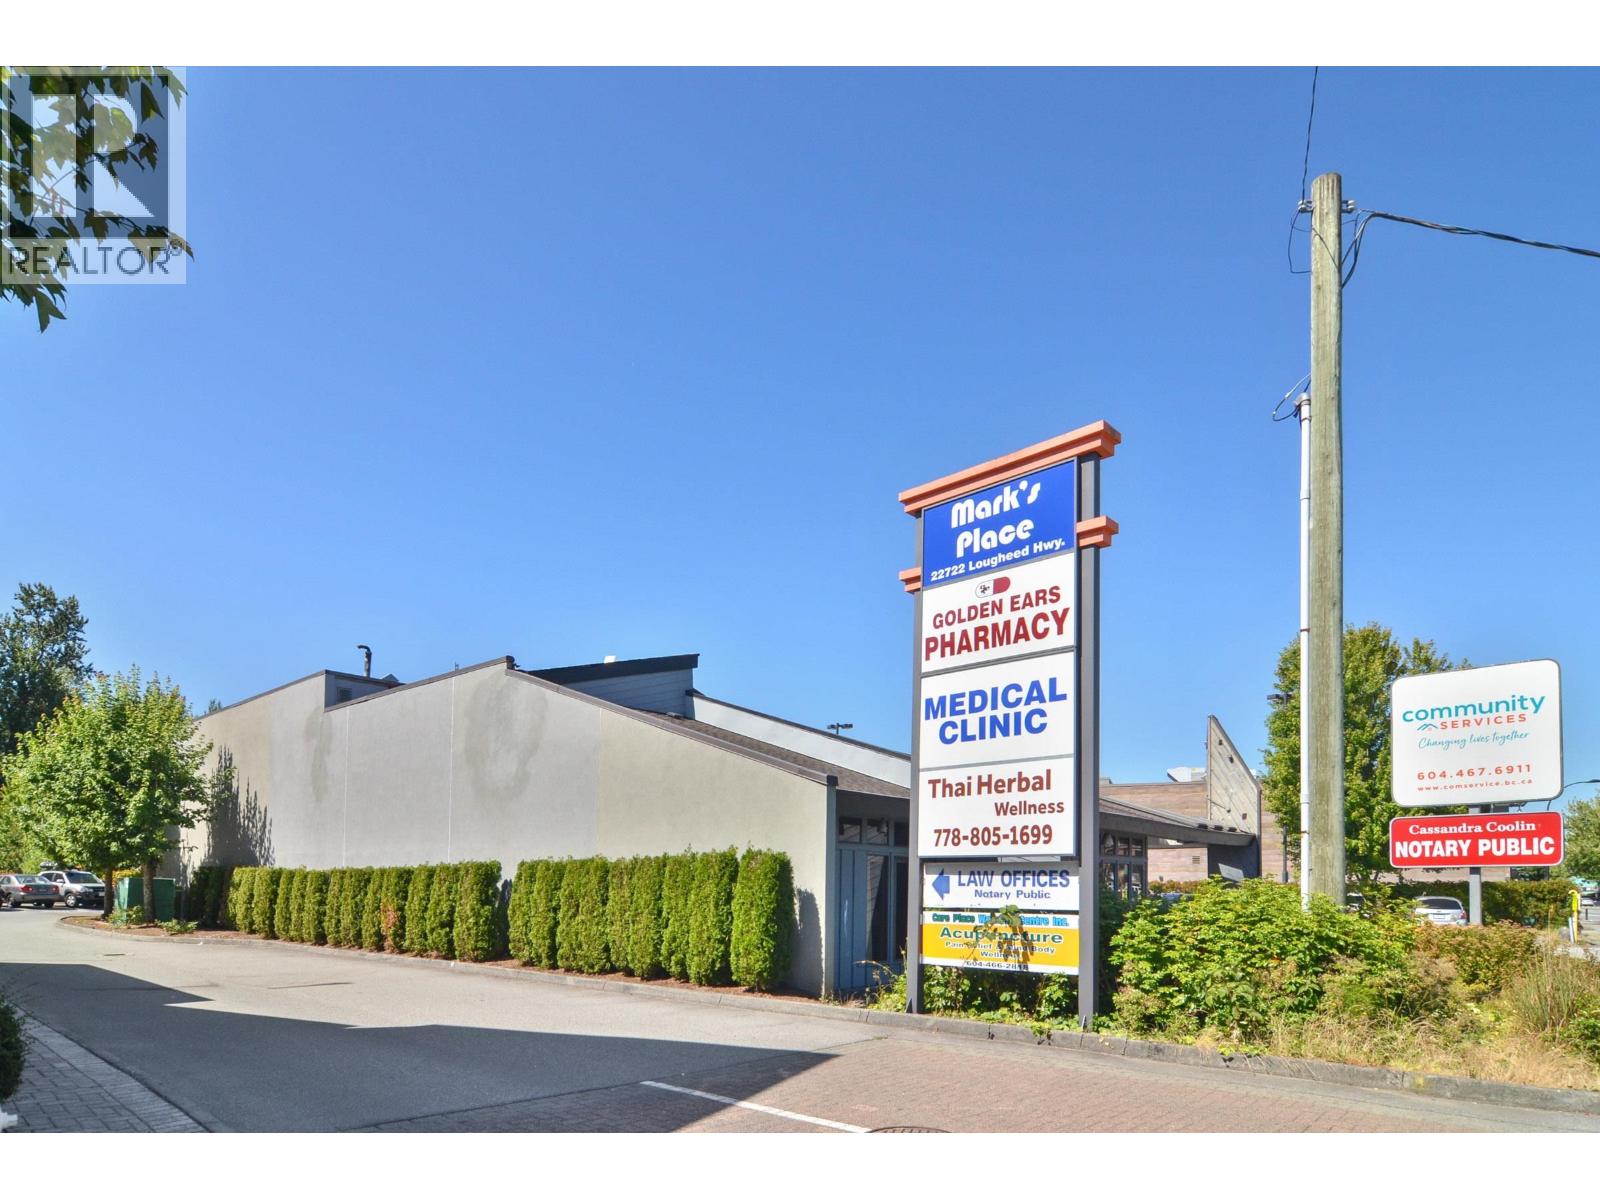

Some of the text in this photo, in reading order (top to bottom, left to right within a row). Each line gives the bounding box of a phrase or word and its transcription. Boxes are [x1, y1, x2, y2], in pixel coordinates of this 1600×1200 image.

[951, 480, 1040, 528] Mark's
[956, 518, 1034, 558] Place
[930, 538, 1065, 582] 22722 Lougheed Hwy.
[932, 585, 1061, 629] GOLDEN EARS
[925, 607, 1070, 661] PHARMACY
[924, 677, 1067, 720] MEDICAL
[1402, 694, 1546, 723] community
[939, 708, 1048, 745] CLINIC
[1439, 713, 1527, 730] SERVICES
[1418, 730, 1530, 751] Changing lives together
[928, 769, 1051, 798] Thai Herbal
[1417, 764, 1531, 781] 604.467.6911
[1417, 779, 1533, 792] www.comservice.bc.ca
[994, 800, 1065, 817] Wellness
[934, 824, 1053, 847] 778-805-1699
[1409, 821, 1536, 835] Cassandra Coolin
[1395, 837, 1555, 858] NOTARY PUBLIC
[957, 869, 1070, 888] LAW OFFICES
[974, 889, 1051, 900] Notary Public
[940, 927, 1063, 943] Acupncture
